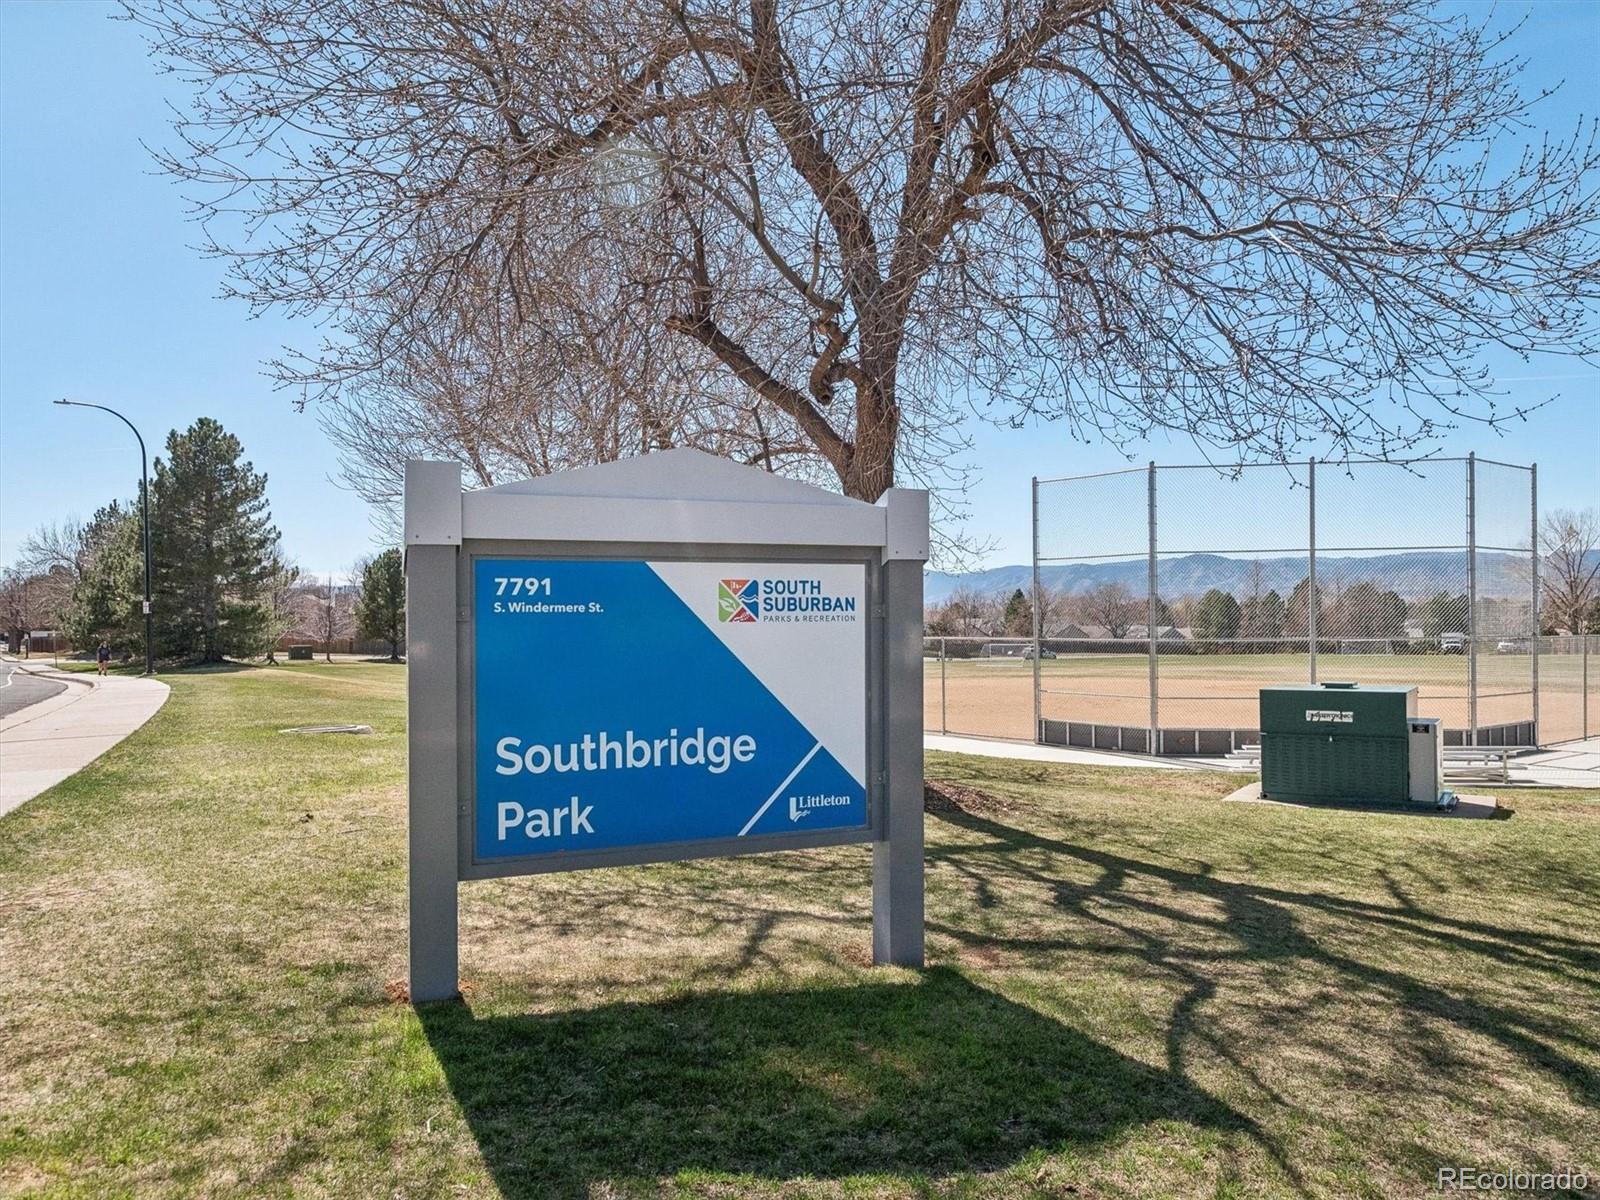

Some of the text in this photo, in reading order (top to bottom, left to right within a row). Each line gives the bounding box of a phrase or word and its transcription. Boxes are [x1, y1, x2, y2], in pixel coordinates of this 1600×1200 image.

[494, 577, 552, 596] 7791
[763, 580, 821, 595] SOUTH
[494, 601, 604, 613] S. Windermere St.
[763, 596, 855, 612] SUBURBAN
[495, 727, 756, 775] Southbridge
[799, 794, 851, 809] Littleton
[497, 796, 595, 841] Park
